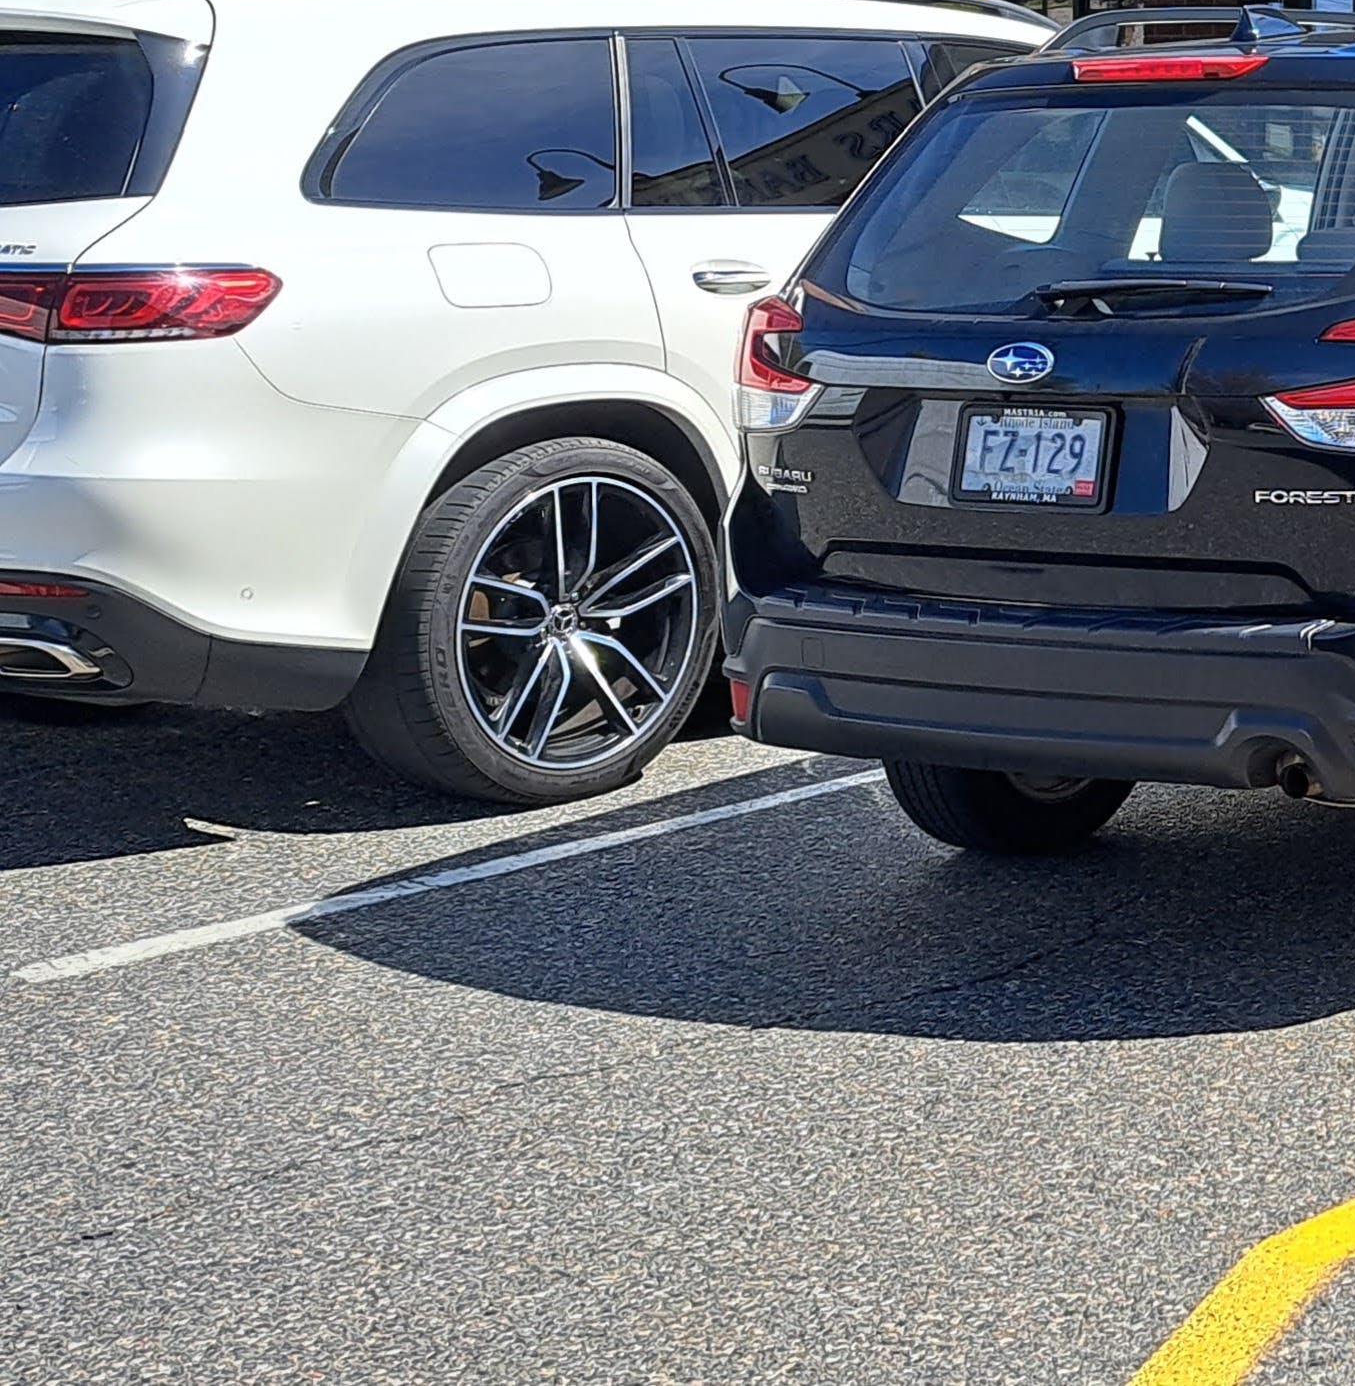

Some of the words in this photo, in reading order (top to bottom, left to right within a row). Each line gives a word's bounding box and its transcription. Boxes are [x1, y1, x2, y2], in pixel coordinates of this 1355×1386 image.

[0, 244, 37, 255] ATIC
[1000, 418, 1035, 429] Rhode
[1039, 418, 1075, 430] Island
[758, 465, 812, 482] SUBARU
[993, 480, 1029, 494] Ocean
[1032, 481, 1065, 494] State
[1042, 494, 1057, 503] MA
